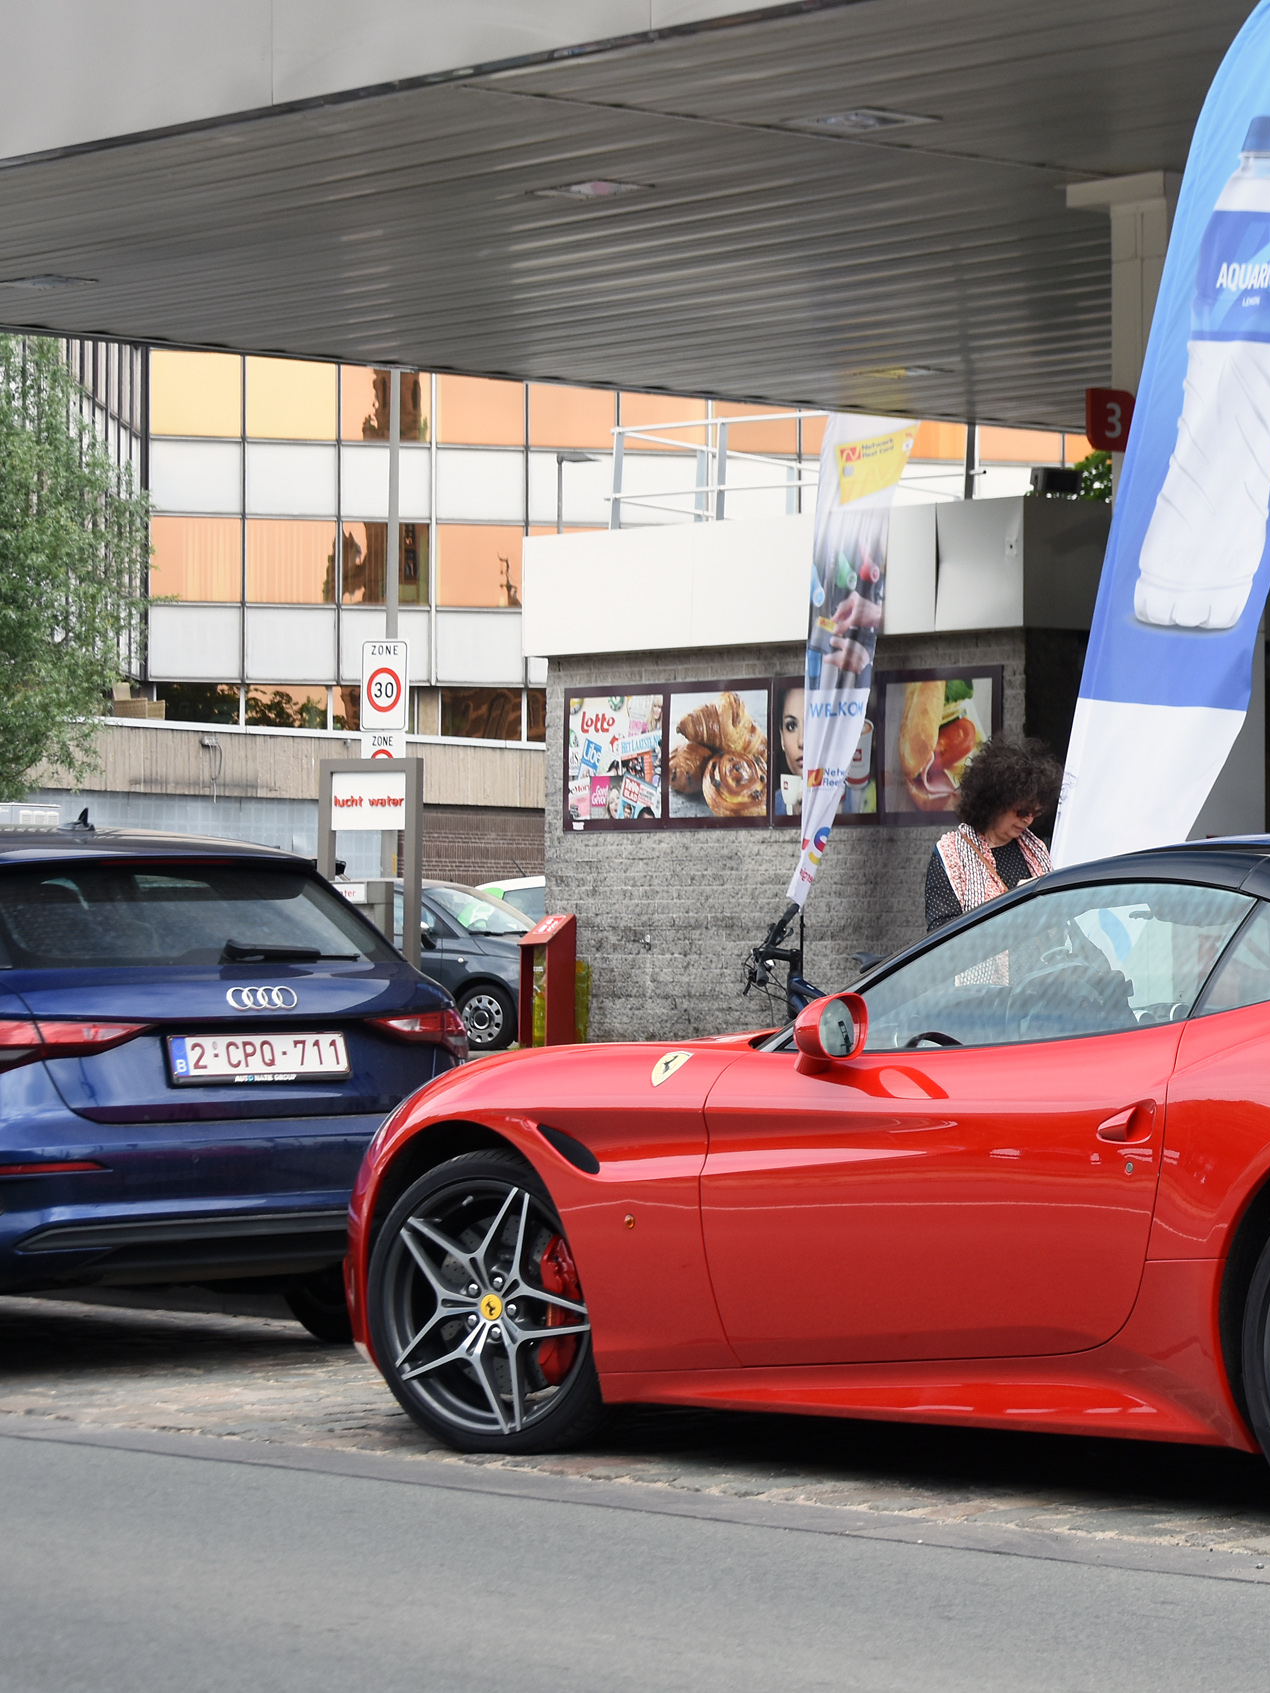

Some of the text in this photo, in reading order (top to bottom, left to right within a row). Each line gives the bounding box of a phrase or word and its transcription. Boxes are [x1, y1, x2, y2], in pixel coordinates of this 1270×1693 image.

[1105, 402, 1122, 438] 3
[371, 645, 399, 656] ZONE
[374, 682, 394, 698] 30
[581, 711, 615, 733] Lotto
[372, 736, 394, 747] ZONE
[334, 795, 404, 808] lucht water
[176, 1059, 187, 1073] B
